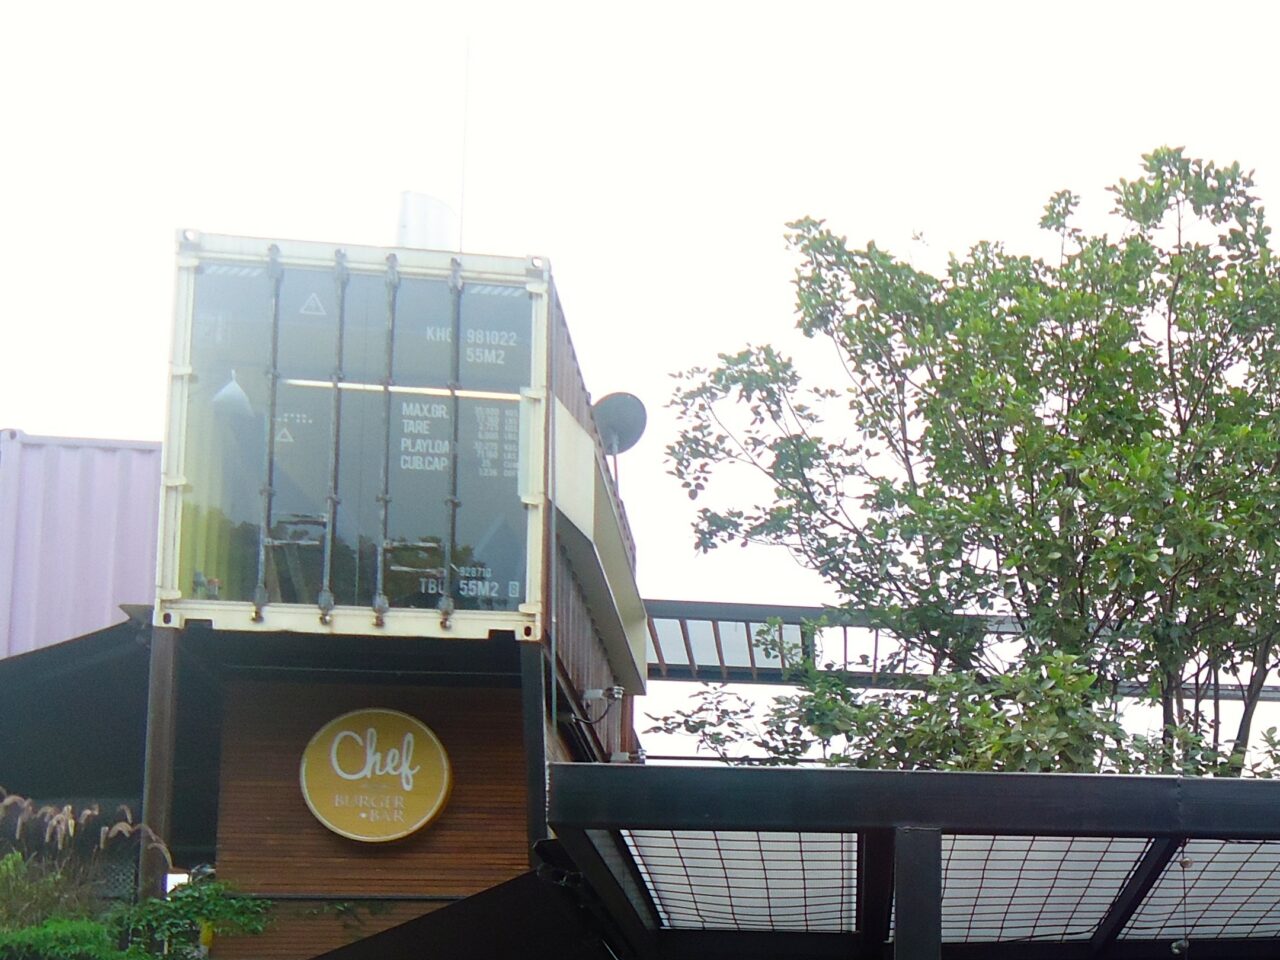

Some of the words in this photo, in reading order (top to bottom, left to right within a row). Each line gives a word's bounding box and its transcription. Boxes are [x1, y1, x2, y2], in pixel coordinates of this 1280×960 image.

[466, 328, 517, 346] 981022
[466, 347, 505, 364] 55M2
[402, 420, 431, 434] TARE
[401, 438, 450, 454] PLAYLOA
[459, 581, 499, 597] 55M2
[331, 727, 421, 792] Chef
[369, 810, 406, 824] BAR
